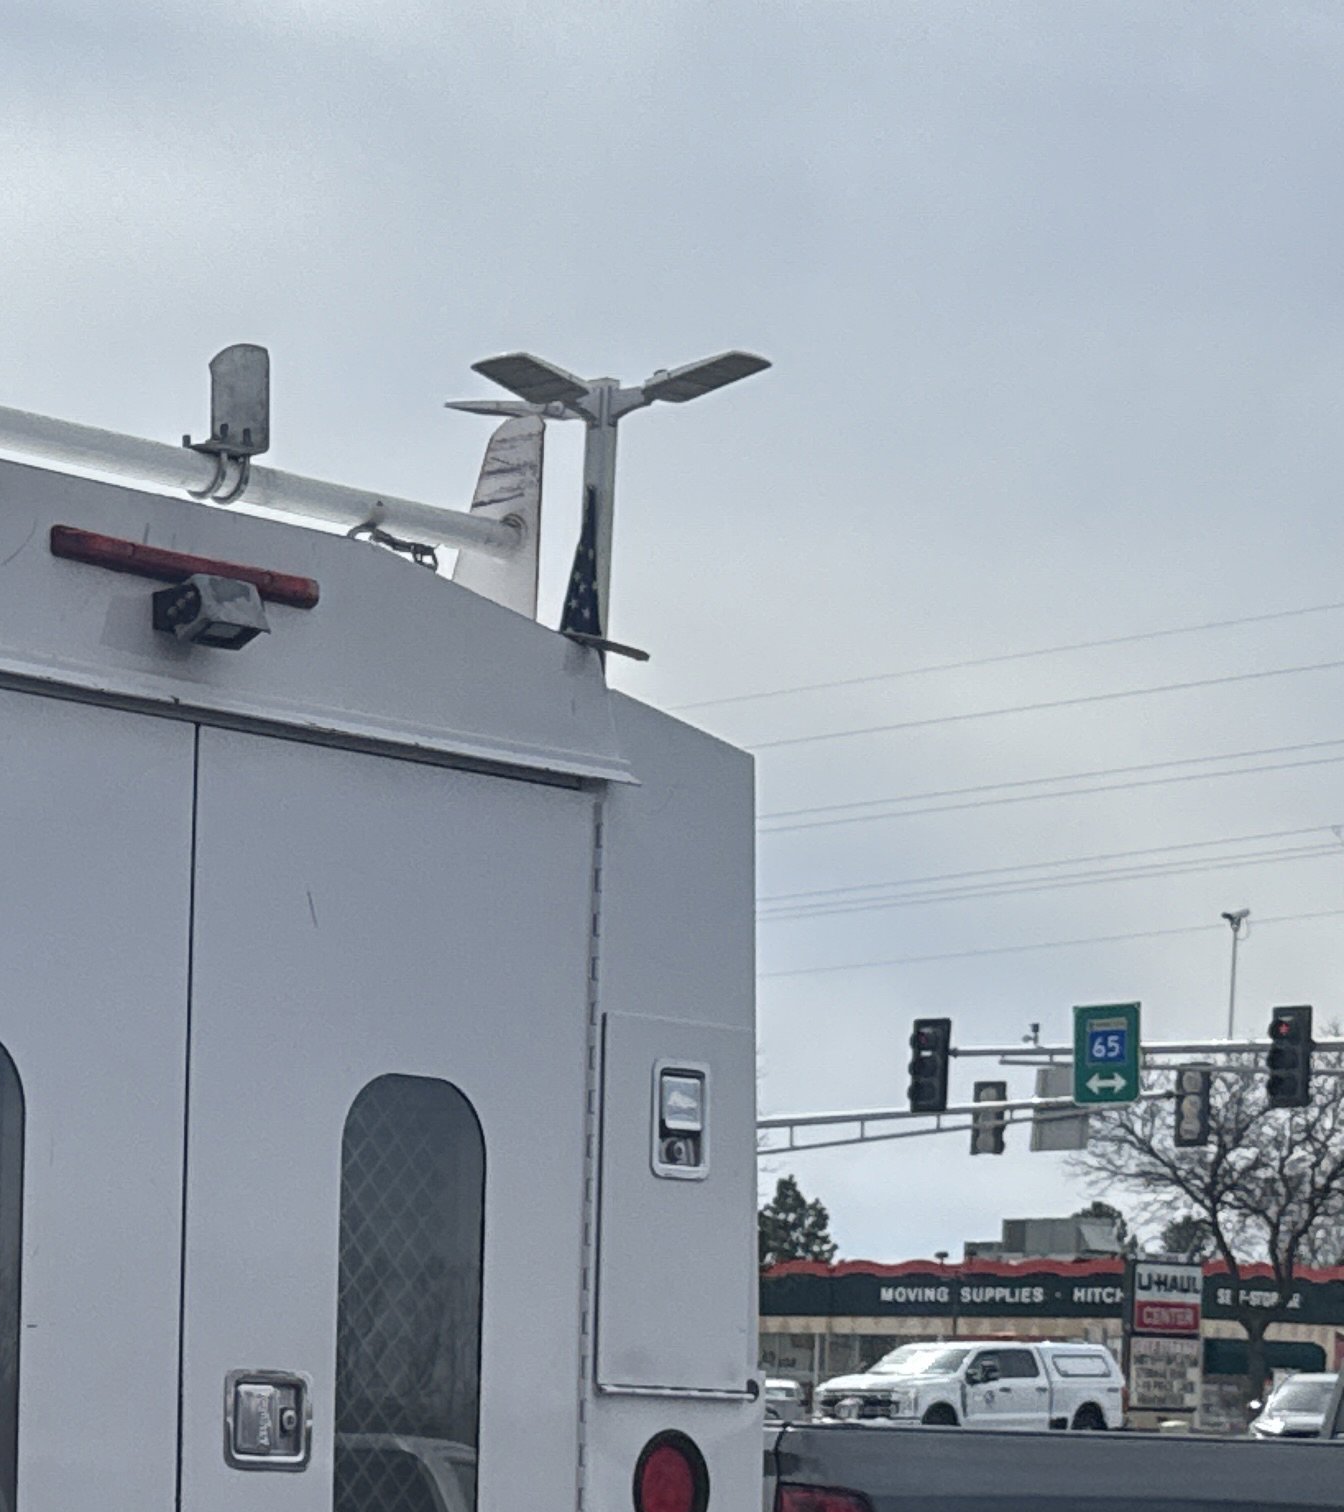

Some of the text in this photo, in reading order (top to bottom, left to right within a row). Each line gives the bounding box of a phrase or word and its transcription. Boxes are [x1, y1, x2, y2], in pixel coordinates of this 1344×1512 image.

[1092, 1035, 1120, 1058] 65
[1137, 1272, 1201, 1294] U-HAUL
[879, 1286, 949, 1303] MOVING
[960, 1286, 1044, 1303] SUPPLIES
[1143, 1306, 1194, 1326] CENTER
